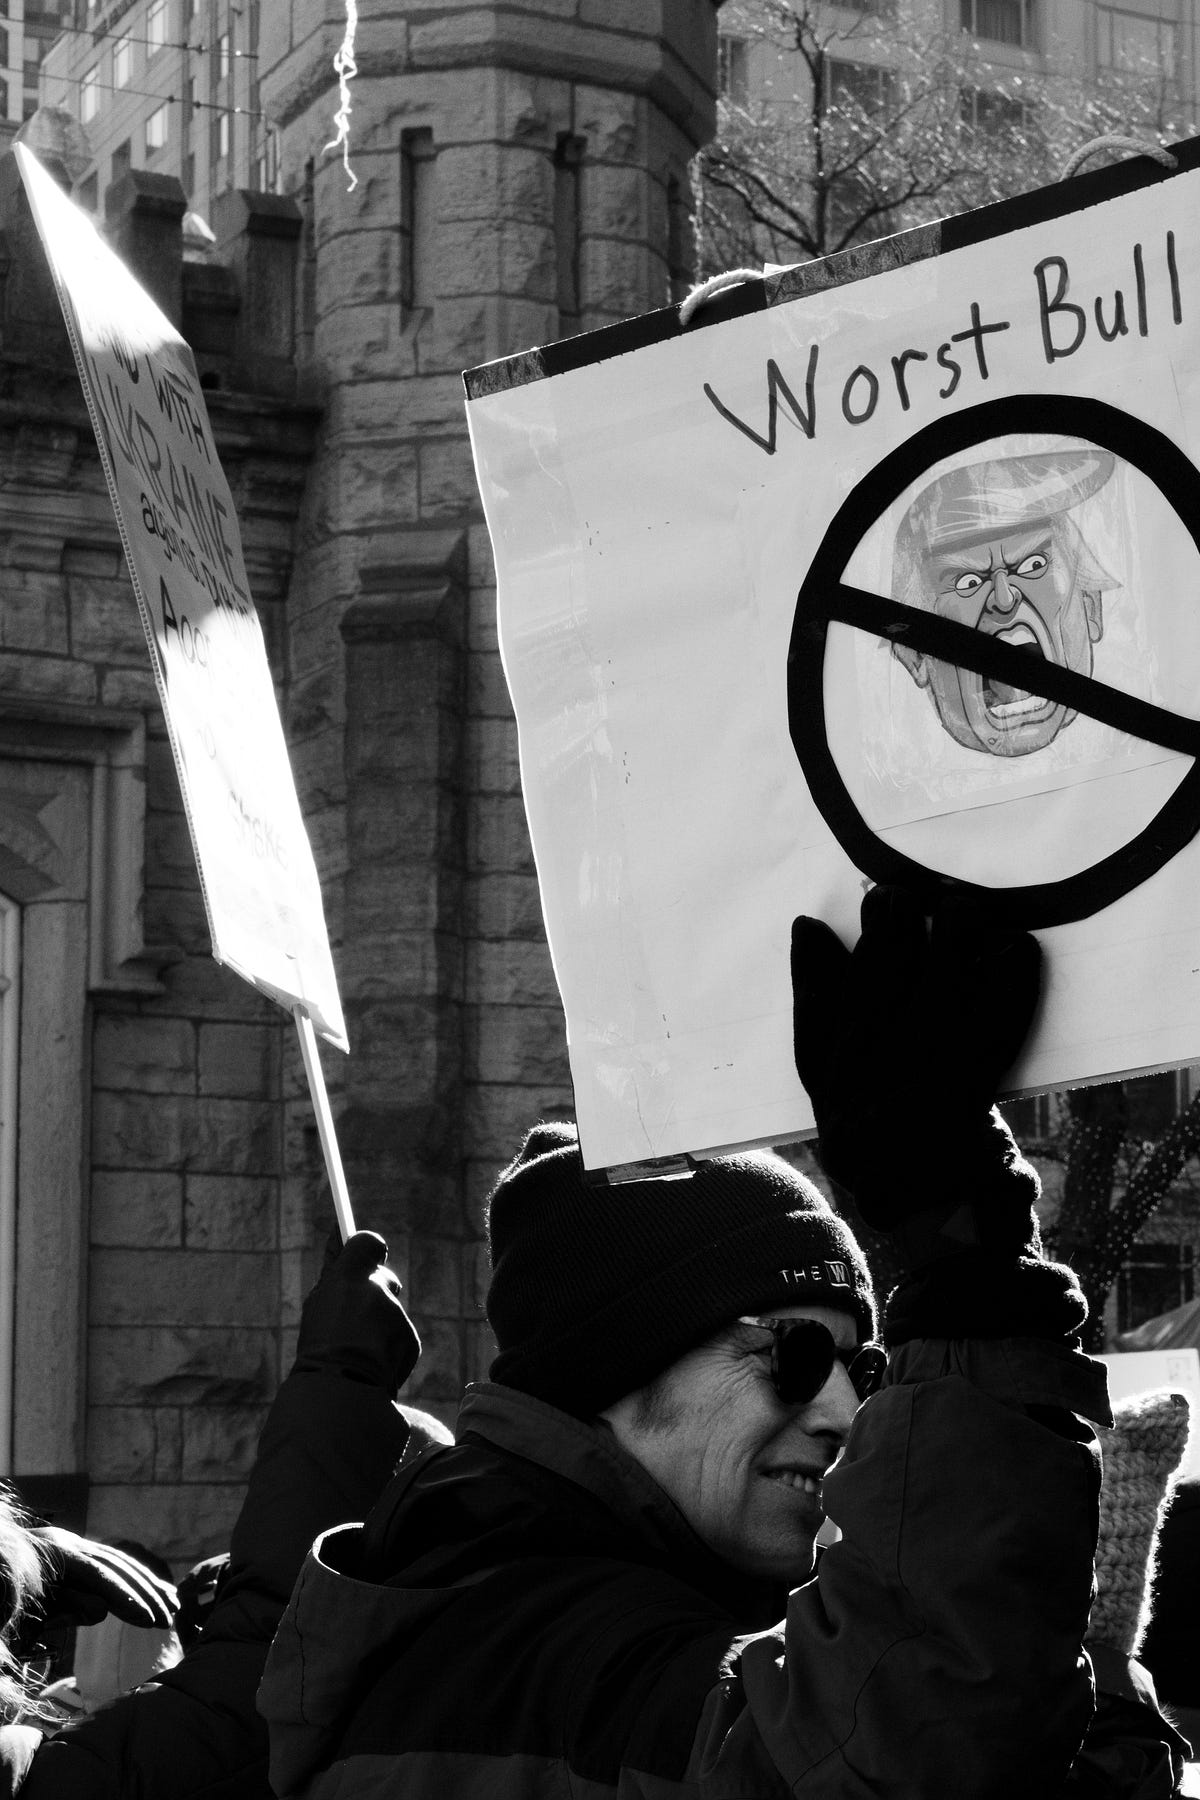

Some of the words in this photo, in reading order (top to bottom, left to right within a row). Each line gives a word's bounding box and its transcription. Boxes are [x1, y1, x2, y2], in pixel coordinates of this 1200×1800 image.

[145, 353, 211, 464] WITH
[703, 302, 1010, 455] Worst
[90, 355, 249, 603] UKRAINE
[779, 1266, 822, 1283] THE
